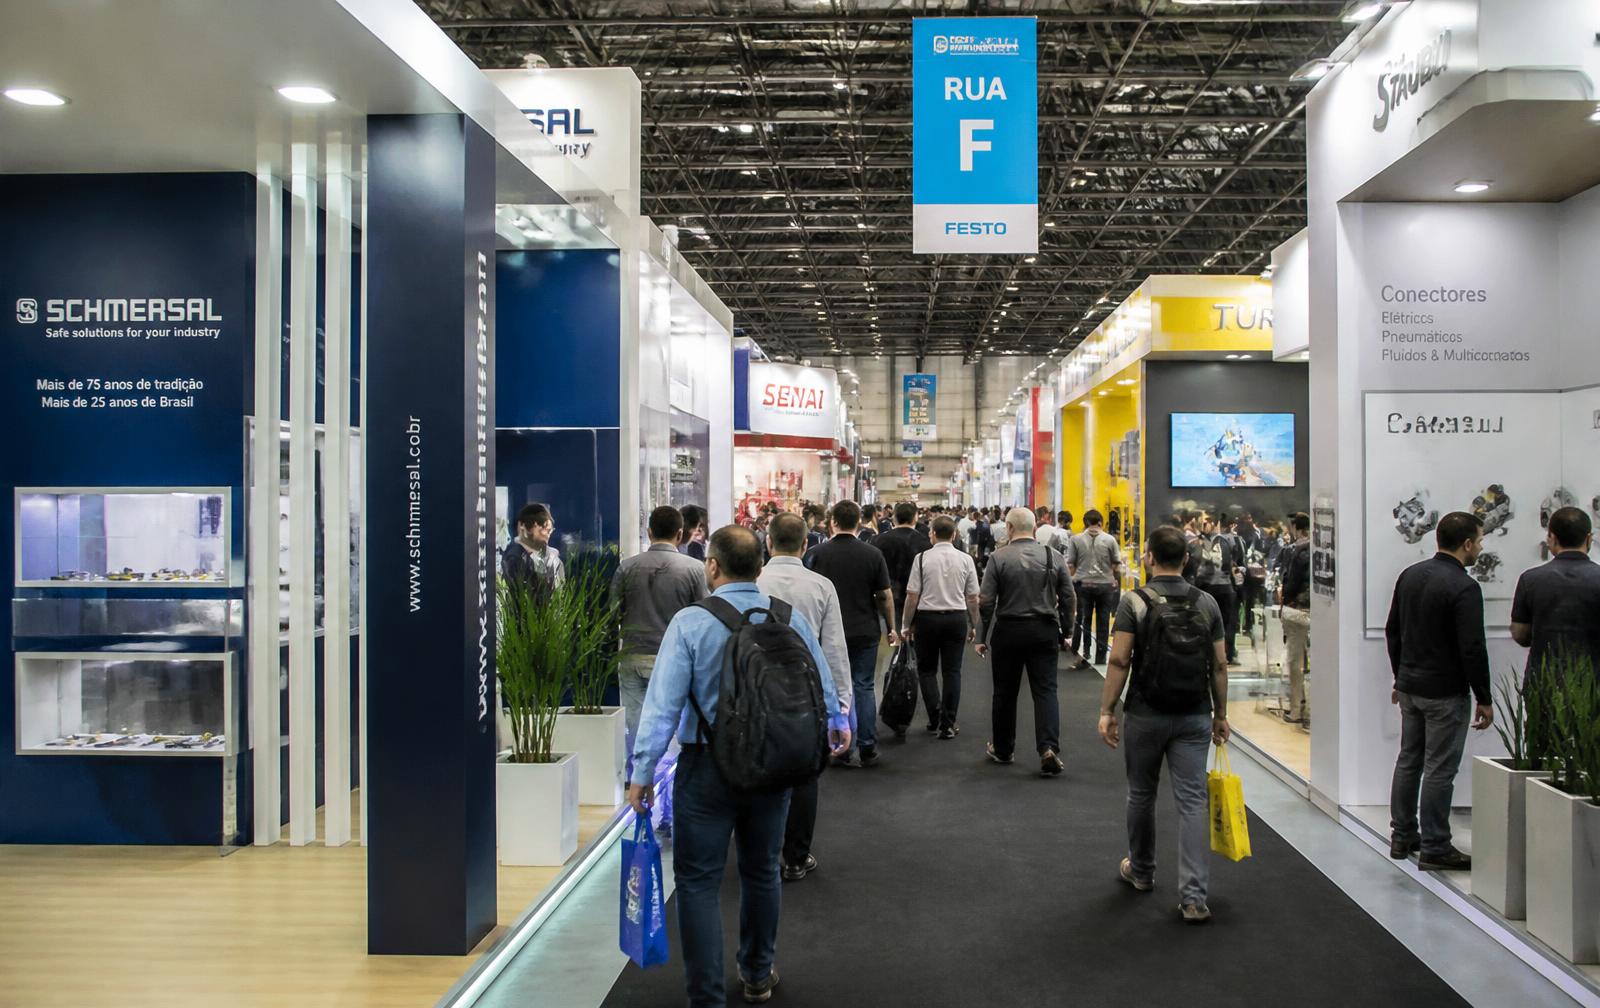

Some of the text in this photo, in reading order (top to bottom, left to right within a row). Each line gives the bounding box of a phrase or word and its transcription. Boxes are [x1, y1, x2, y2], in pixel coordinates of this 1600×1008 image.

[944, 76, 1008, 101] RUA
[959, 119, 995, 172] F
[945, 222, 1008, 235] FESTO
[1380, 285, 1487, 302] Conectores
[46, 298, 222, 322] SCHMERSAL
[45, 327, 221, 339] Safe solutions for your industry
[1381, 348, 1427, 361] Fluidos
[1431, 349, 1439, 361] &
[36, 378, 204, 393] Mais de 75 anos de tradição
[41, 396, 194, 408] Mais de 25 anos de Brasil
[762, 383, 824, 410] SENAI
